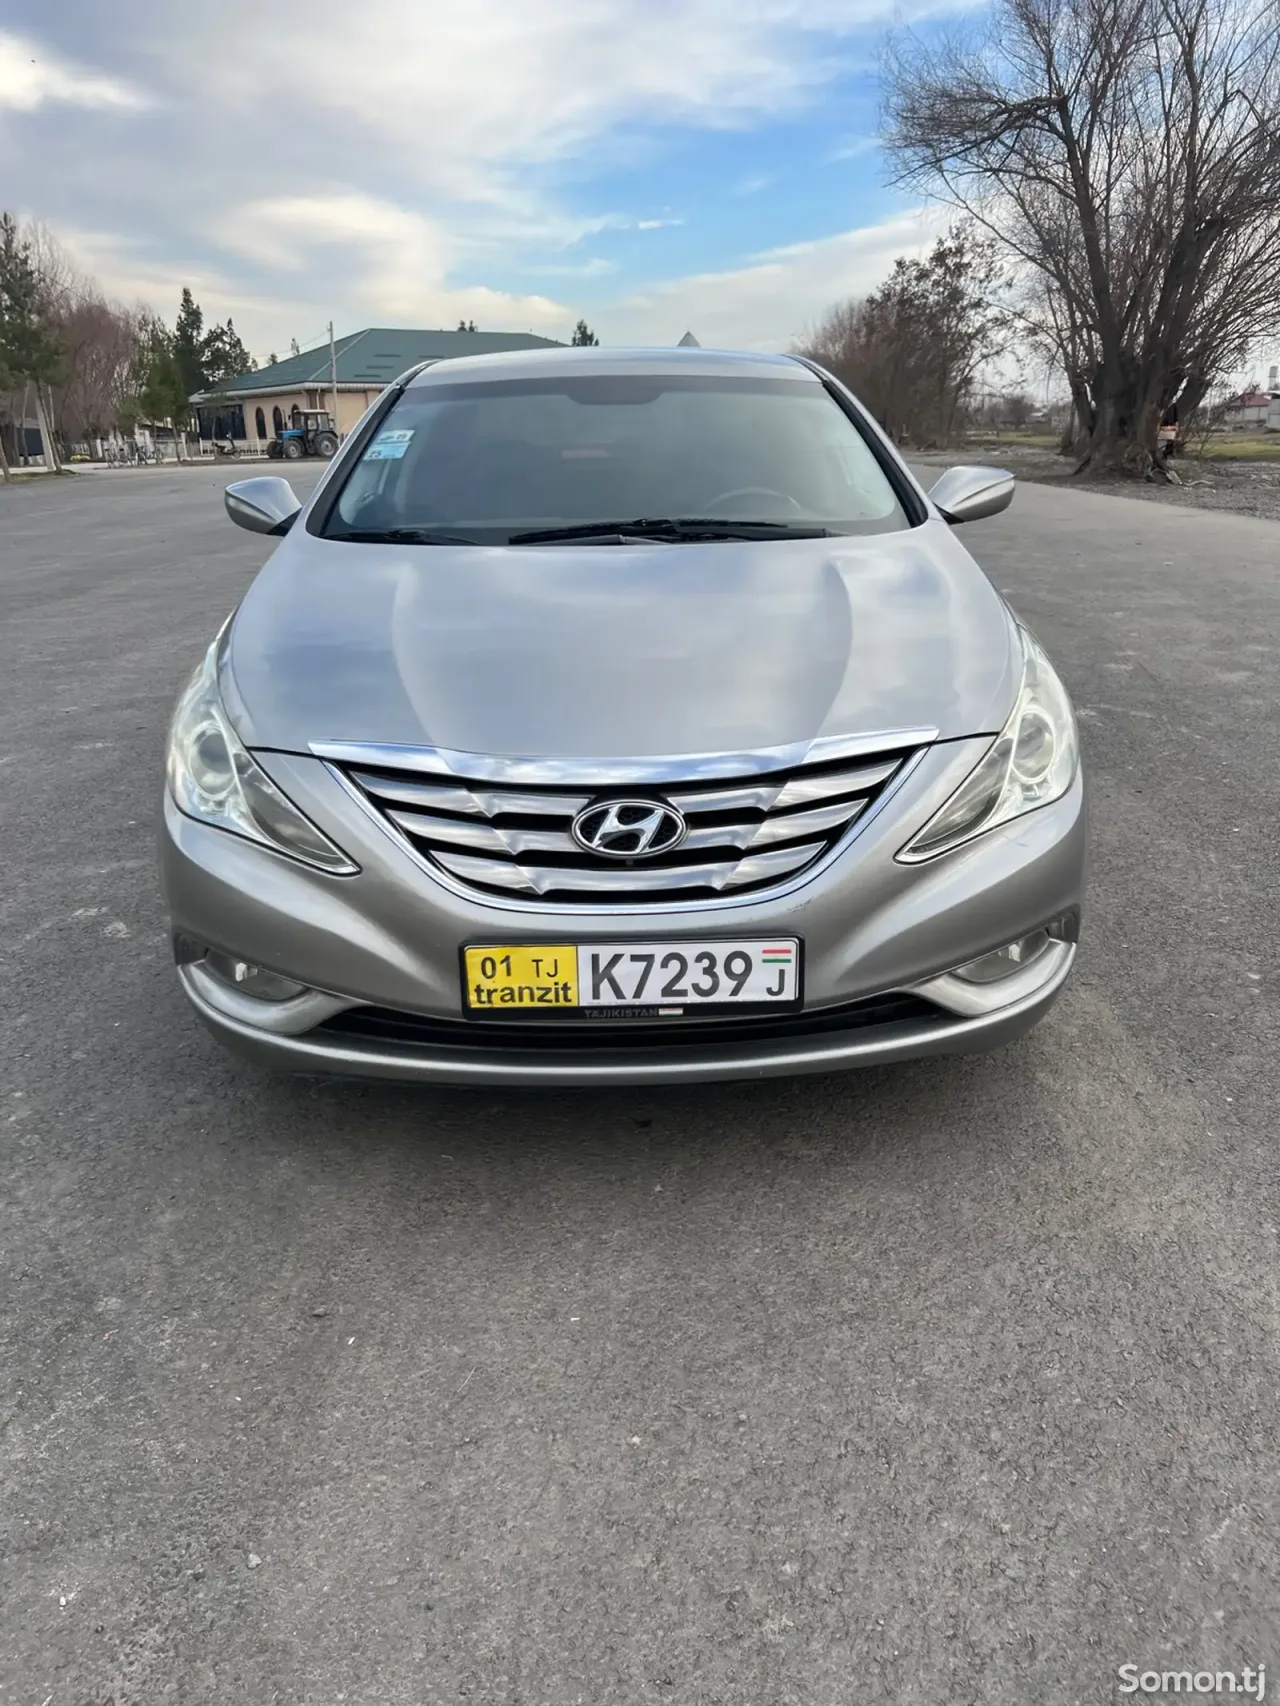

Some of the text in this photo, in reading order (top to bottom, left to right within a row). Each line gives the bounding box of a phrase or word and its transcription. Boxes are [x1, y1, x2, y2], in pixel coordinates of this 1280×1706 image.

[480, 955, 558, 979] 01 TJ
[591, 950, 786, 1000] K7239 J
[473, 981, 572, 1005] tranzit
[584, 1008, 659, 1018] TAJIKISTAN
